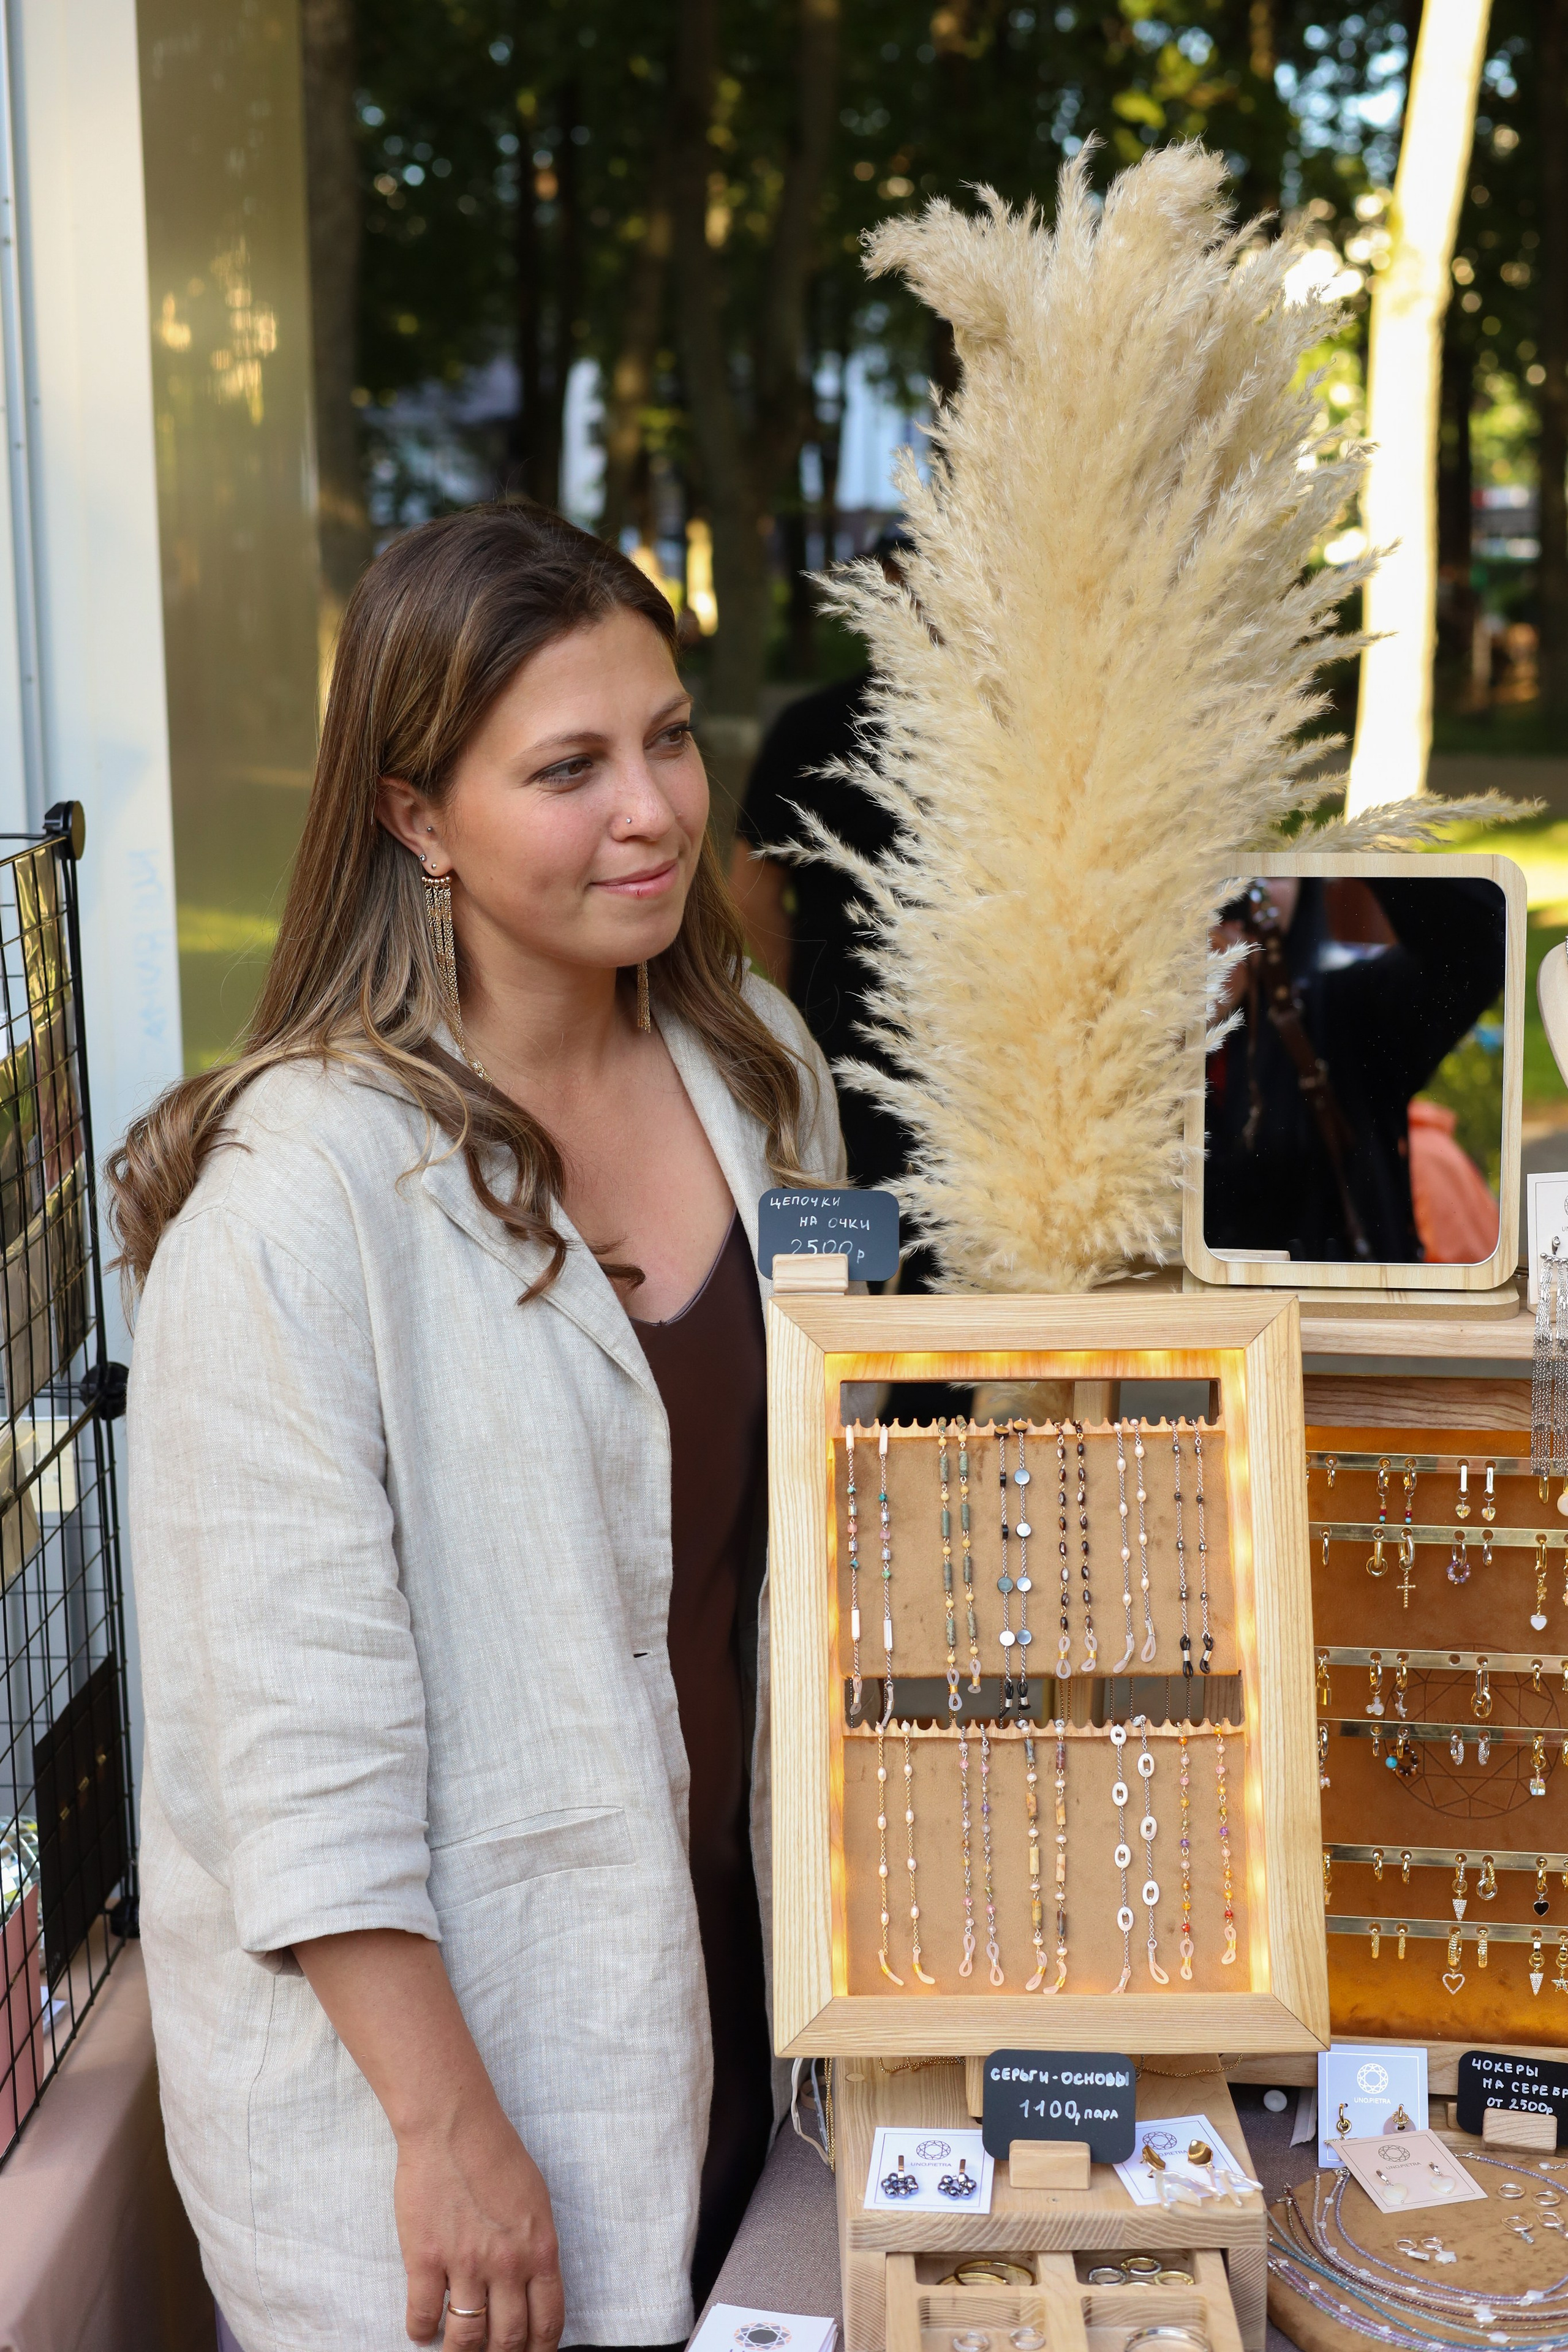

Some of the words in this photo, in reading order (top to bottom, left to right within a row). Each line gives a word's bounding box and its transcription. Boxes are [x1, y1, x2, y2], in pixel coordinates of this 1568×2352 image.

[770, 1196, 841, 1209] ЦЕПОЧКИ
[799, 1216, 818, 1227] НА
[828, 1218, 870, 1231] ОЧКИ
[1471, 2058, 1539, 2077] ЧОКЕРЫ
[1483, 2078, 1504, 2089] НА
[1487, 2097, 1503, 2108] ОТ
